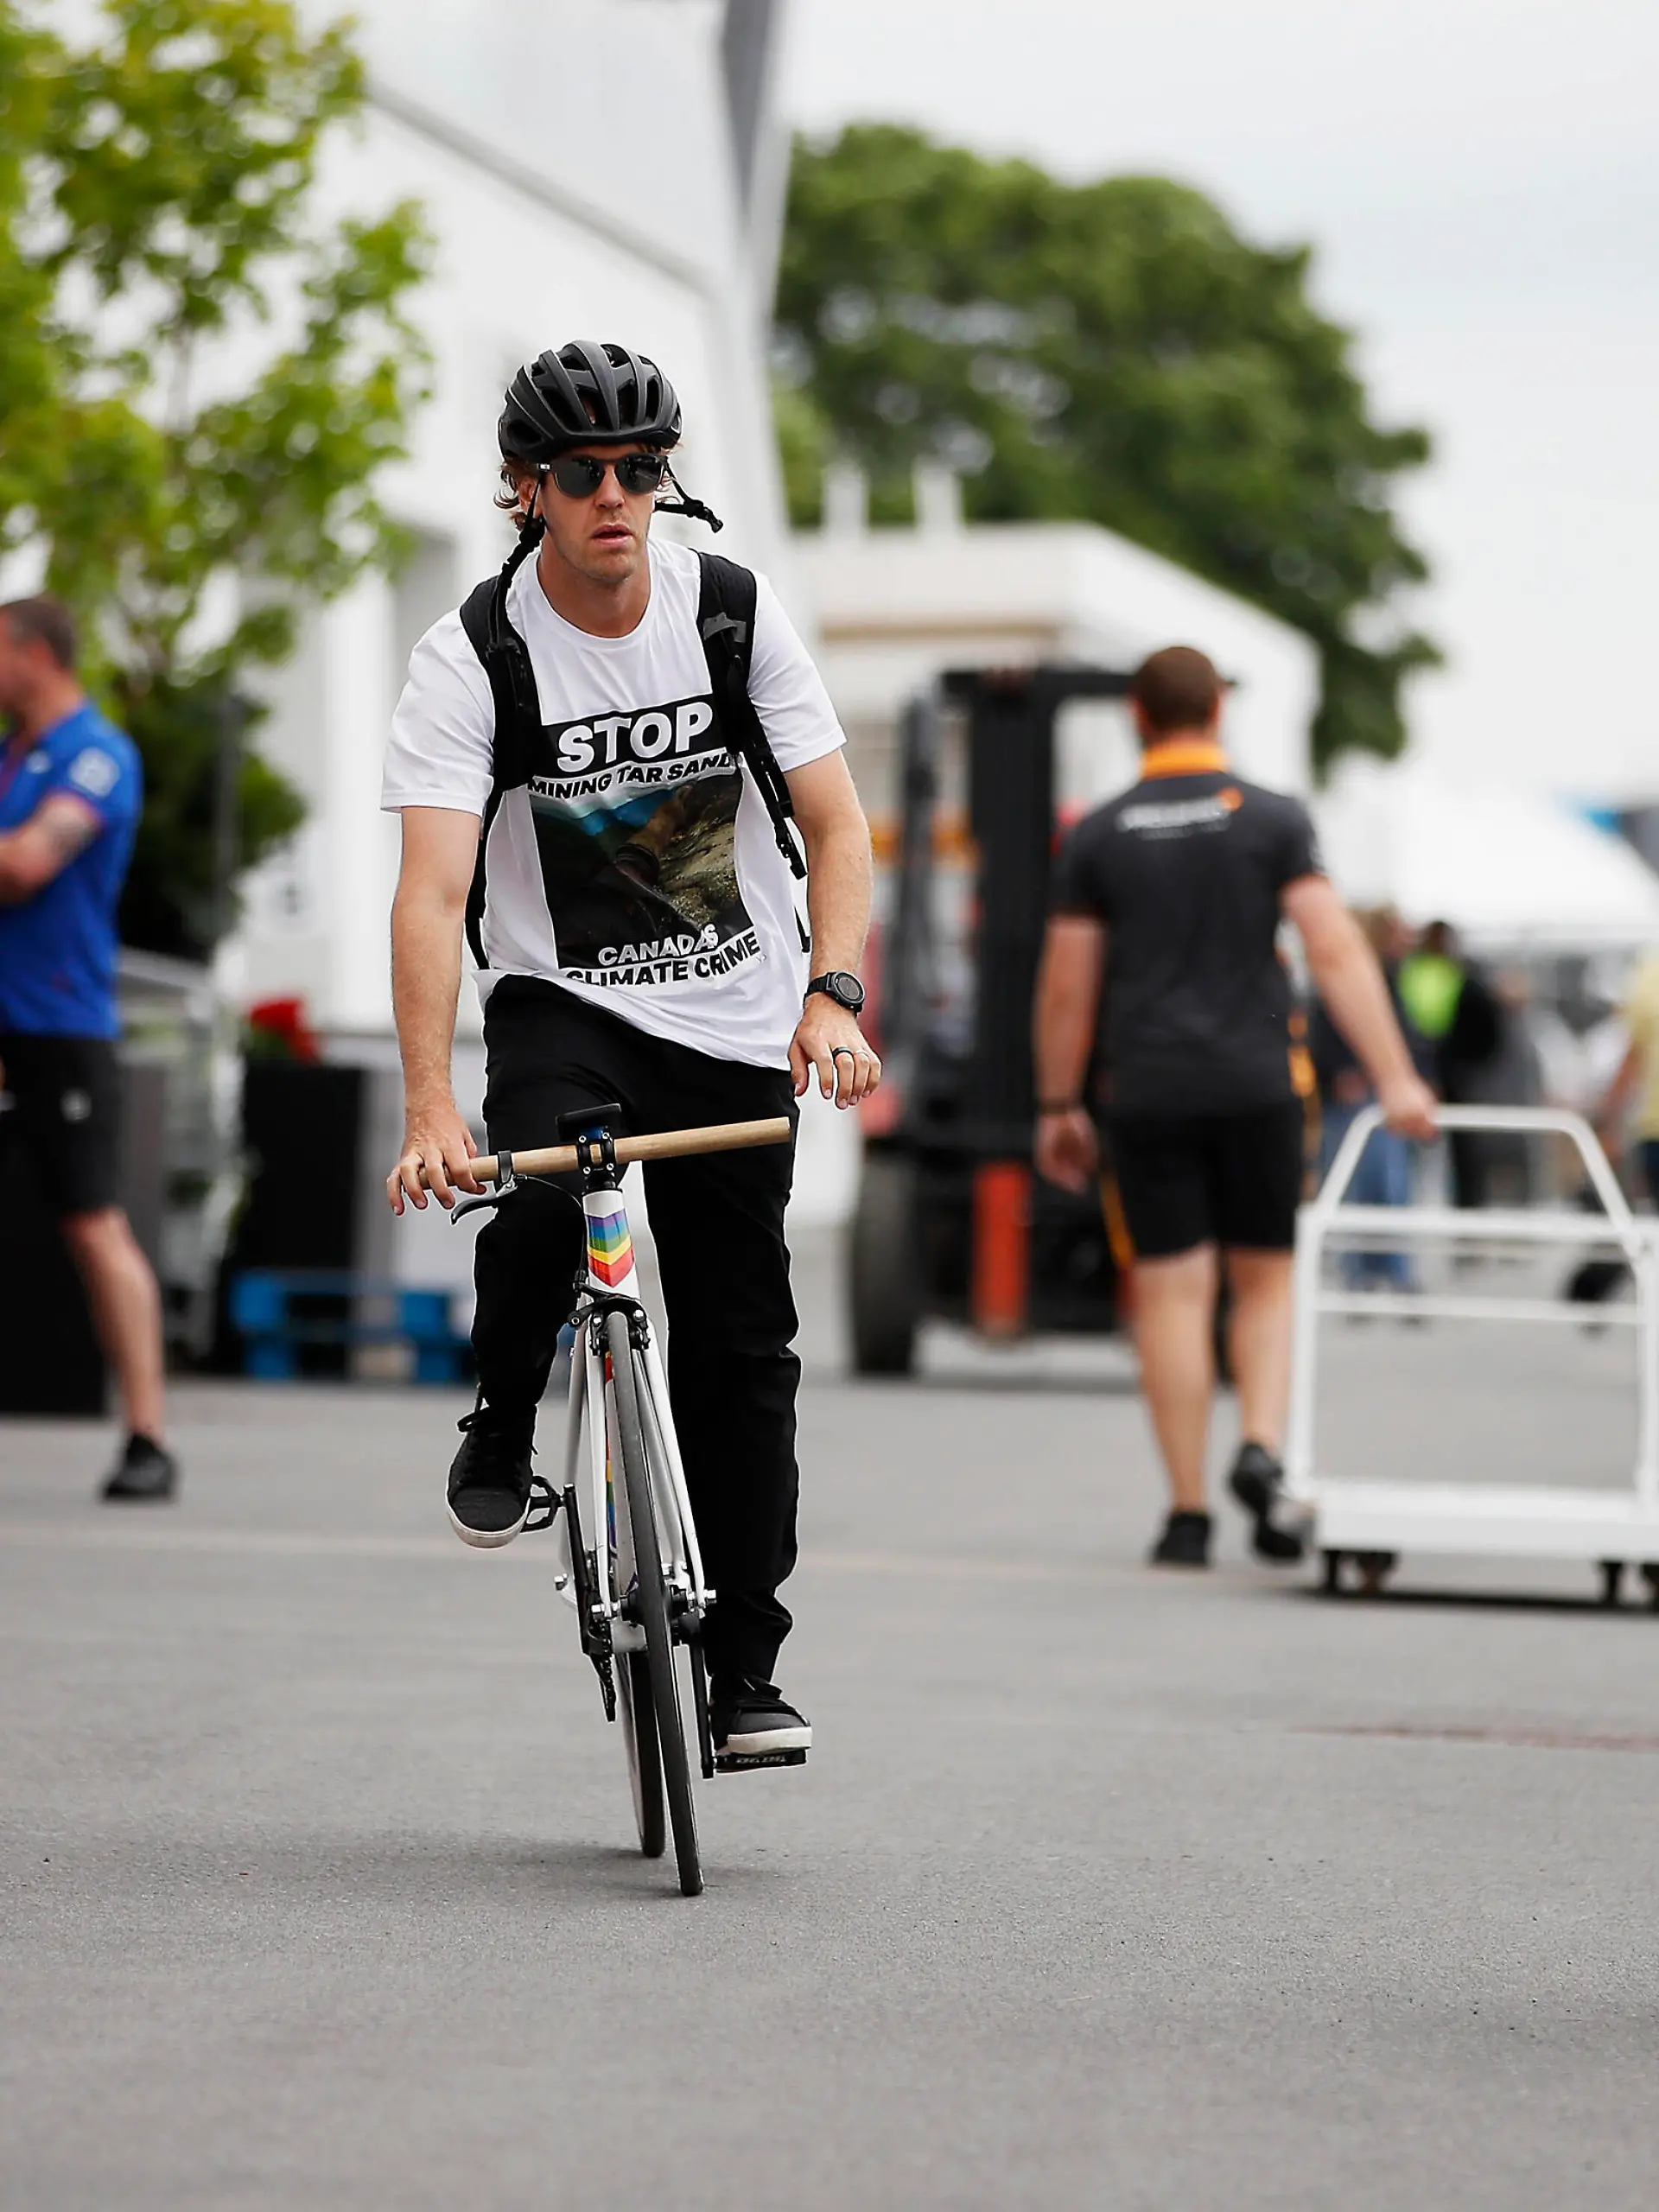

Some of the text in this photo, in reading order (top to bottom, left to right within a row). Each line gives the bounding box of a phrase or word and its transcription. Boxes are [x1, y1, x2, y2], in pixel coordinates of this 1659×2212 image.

[556, 702, 713, 772] STOP
[528, 775, 613, 800] MINING
[616, 765, 664, 784] TAR
[565, 931, 761, 986] CLIMATE CRIME
